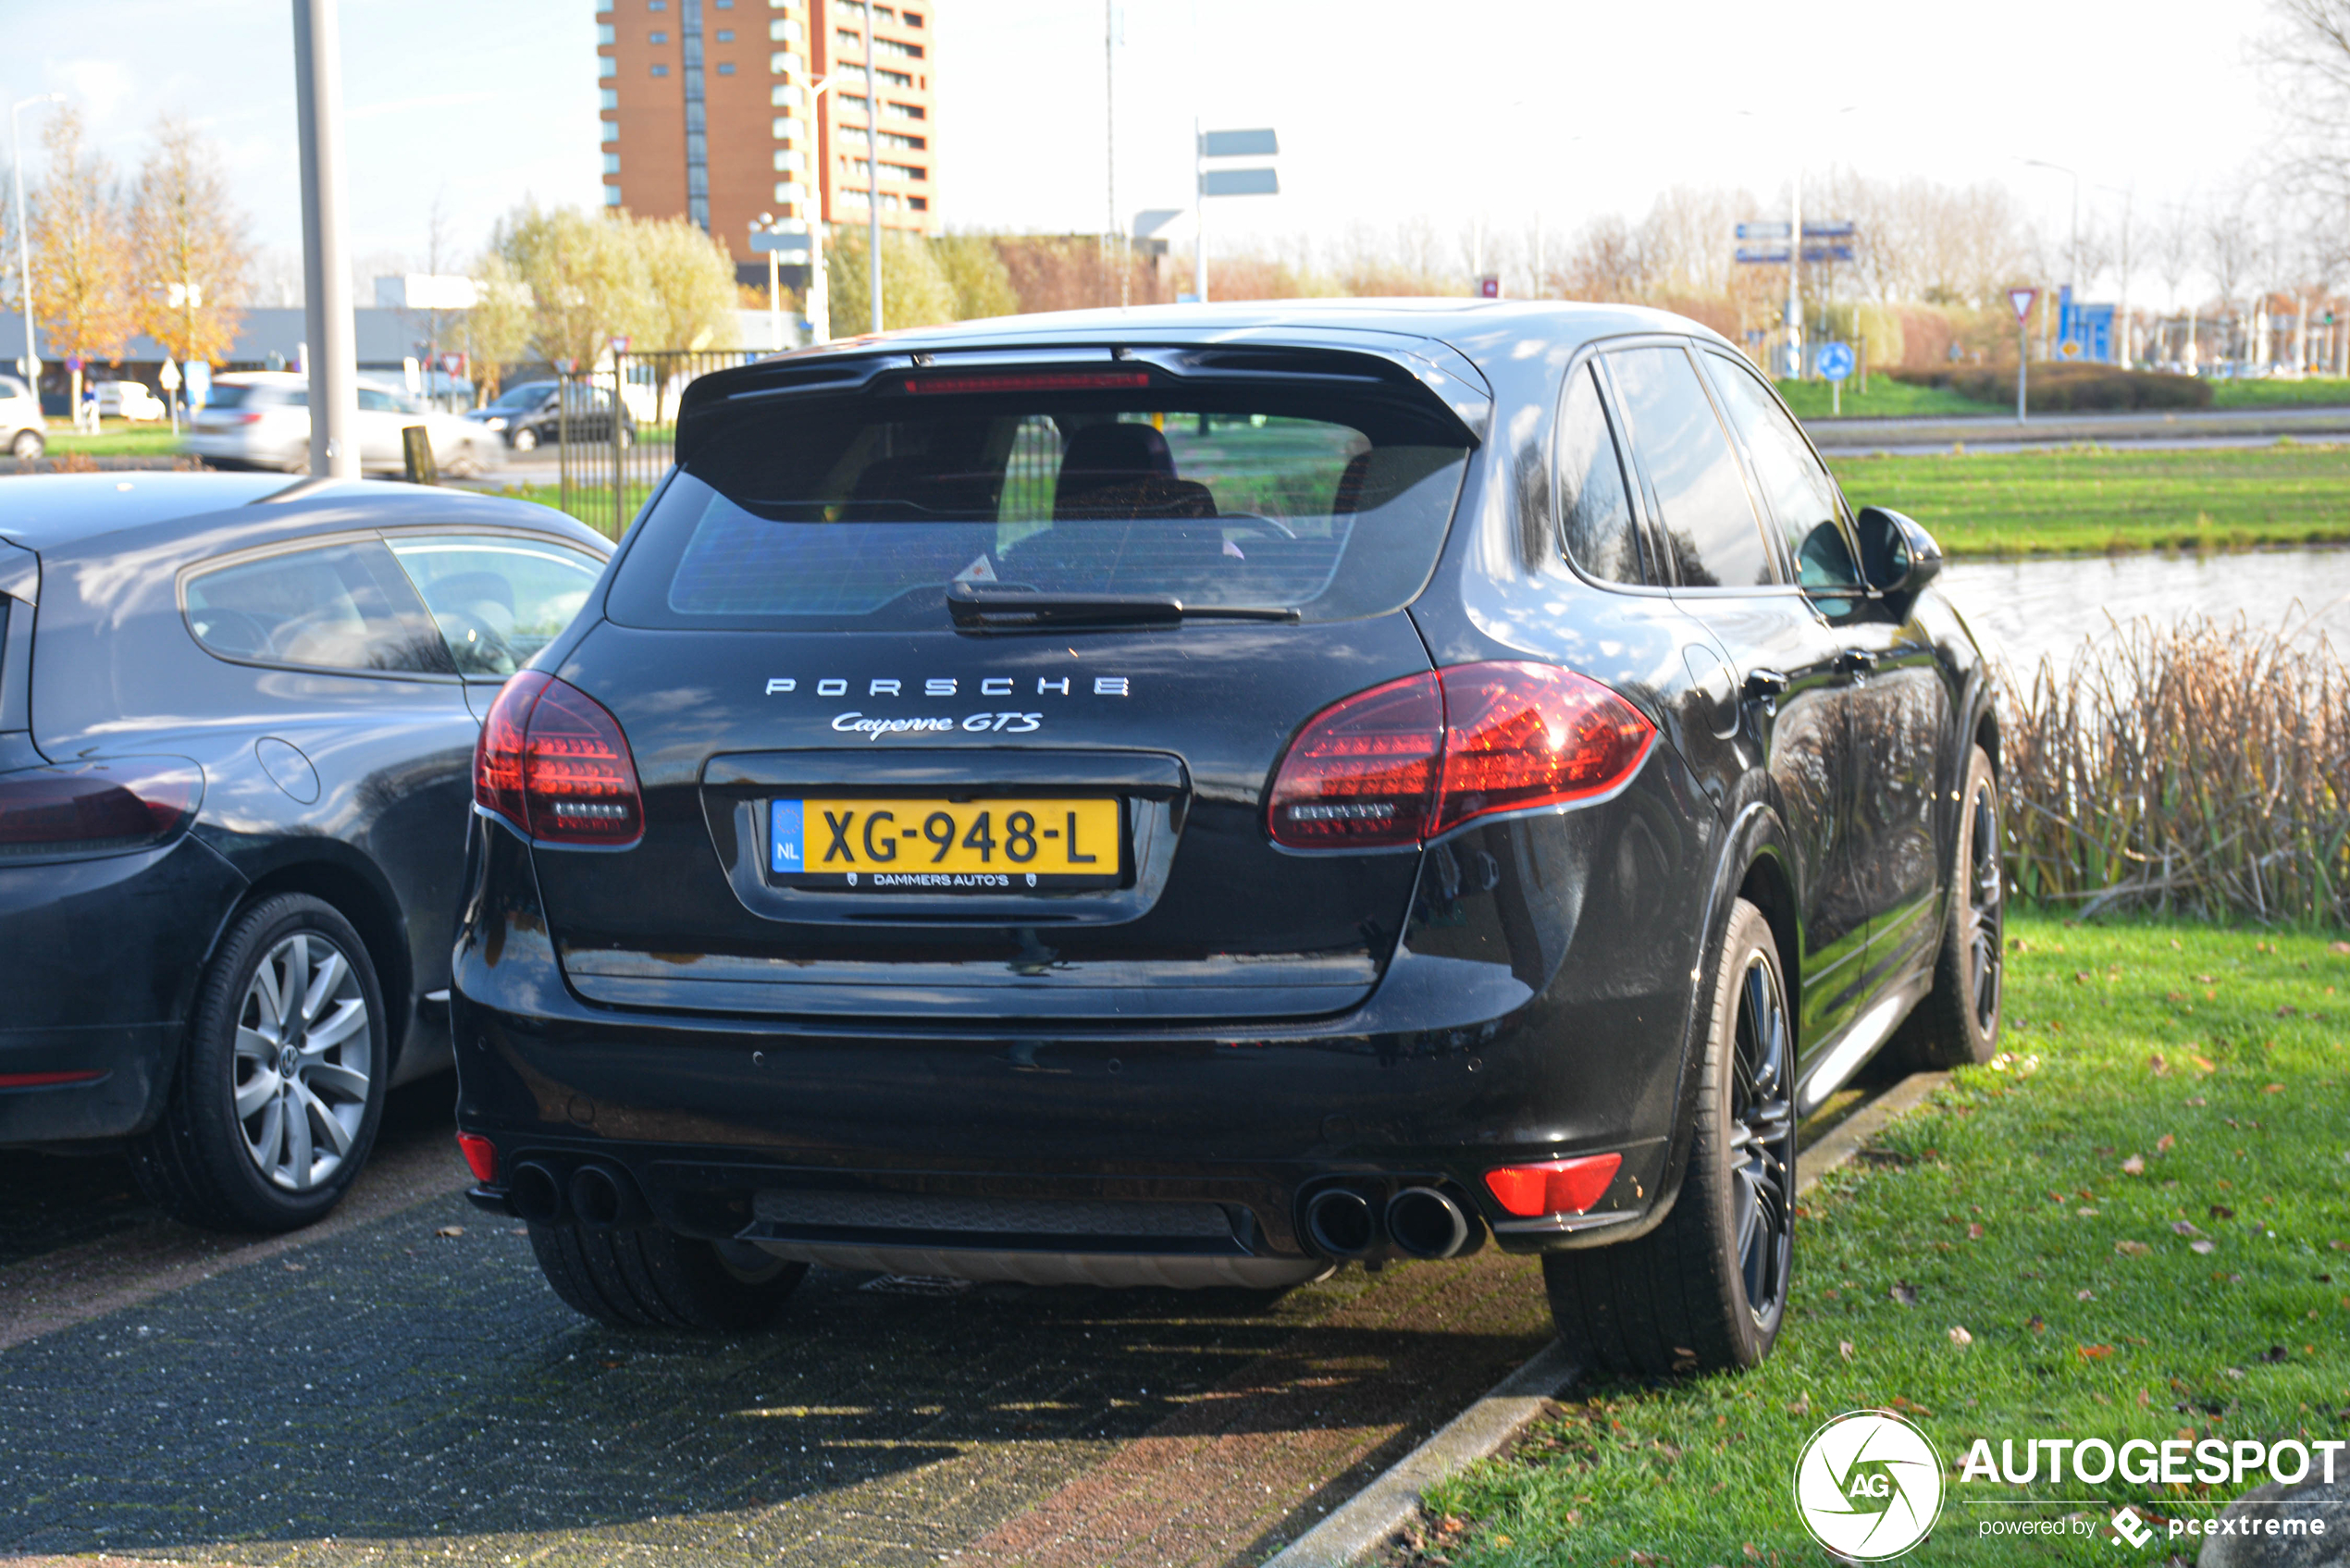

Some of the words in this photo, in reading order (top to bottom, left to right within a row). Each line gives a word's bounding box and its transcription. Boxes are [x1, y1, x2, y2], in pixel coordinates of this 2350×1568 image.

[765, 676, 1130, 697] PORSCHE
[831, 712, 955, 742] Cayenne
[961, 712, 1044, 733] GTS
[823, 811, 1096, 863] XG-948-L
[777, 844, 800, 859] NL
[873, 873, 952, 886] DAMMERS
[953, 873, 1009, 886] AUTO'S
